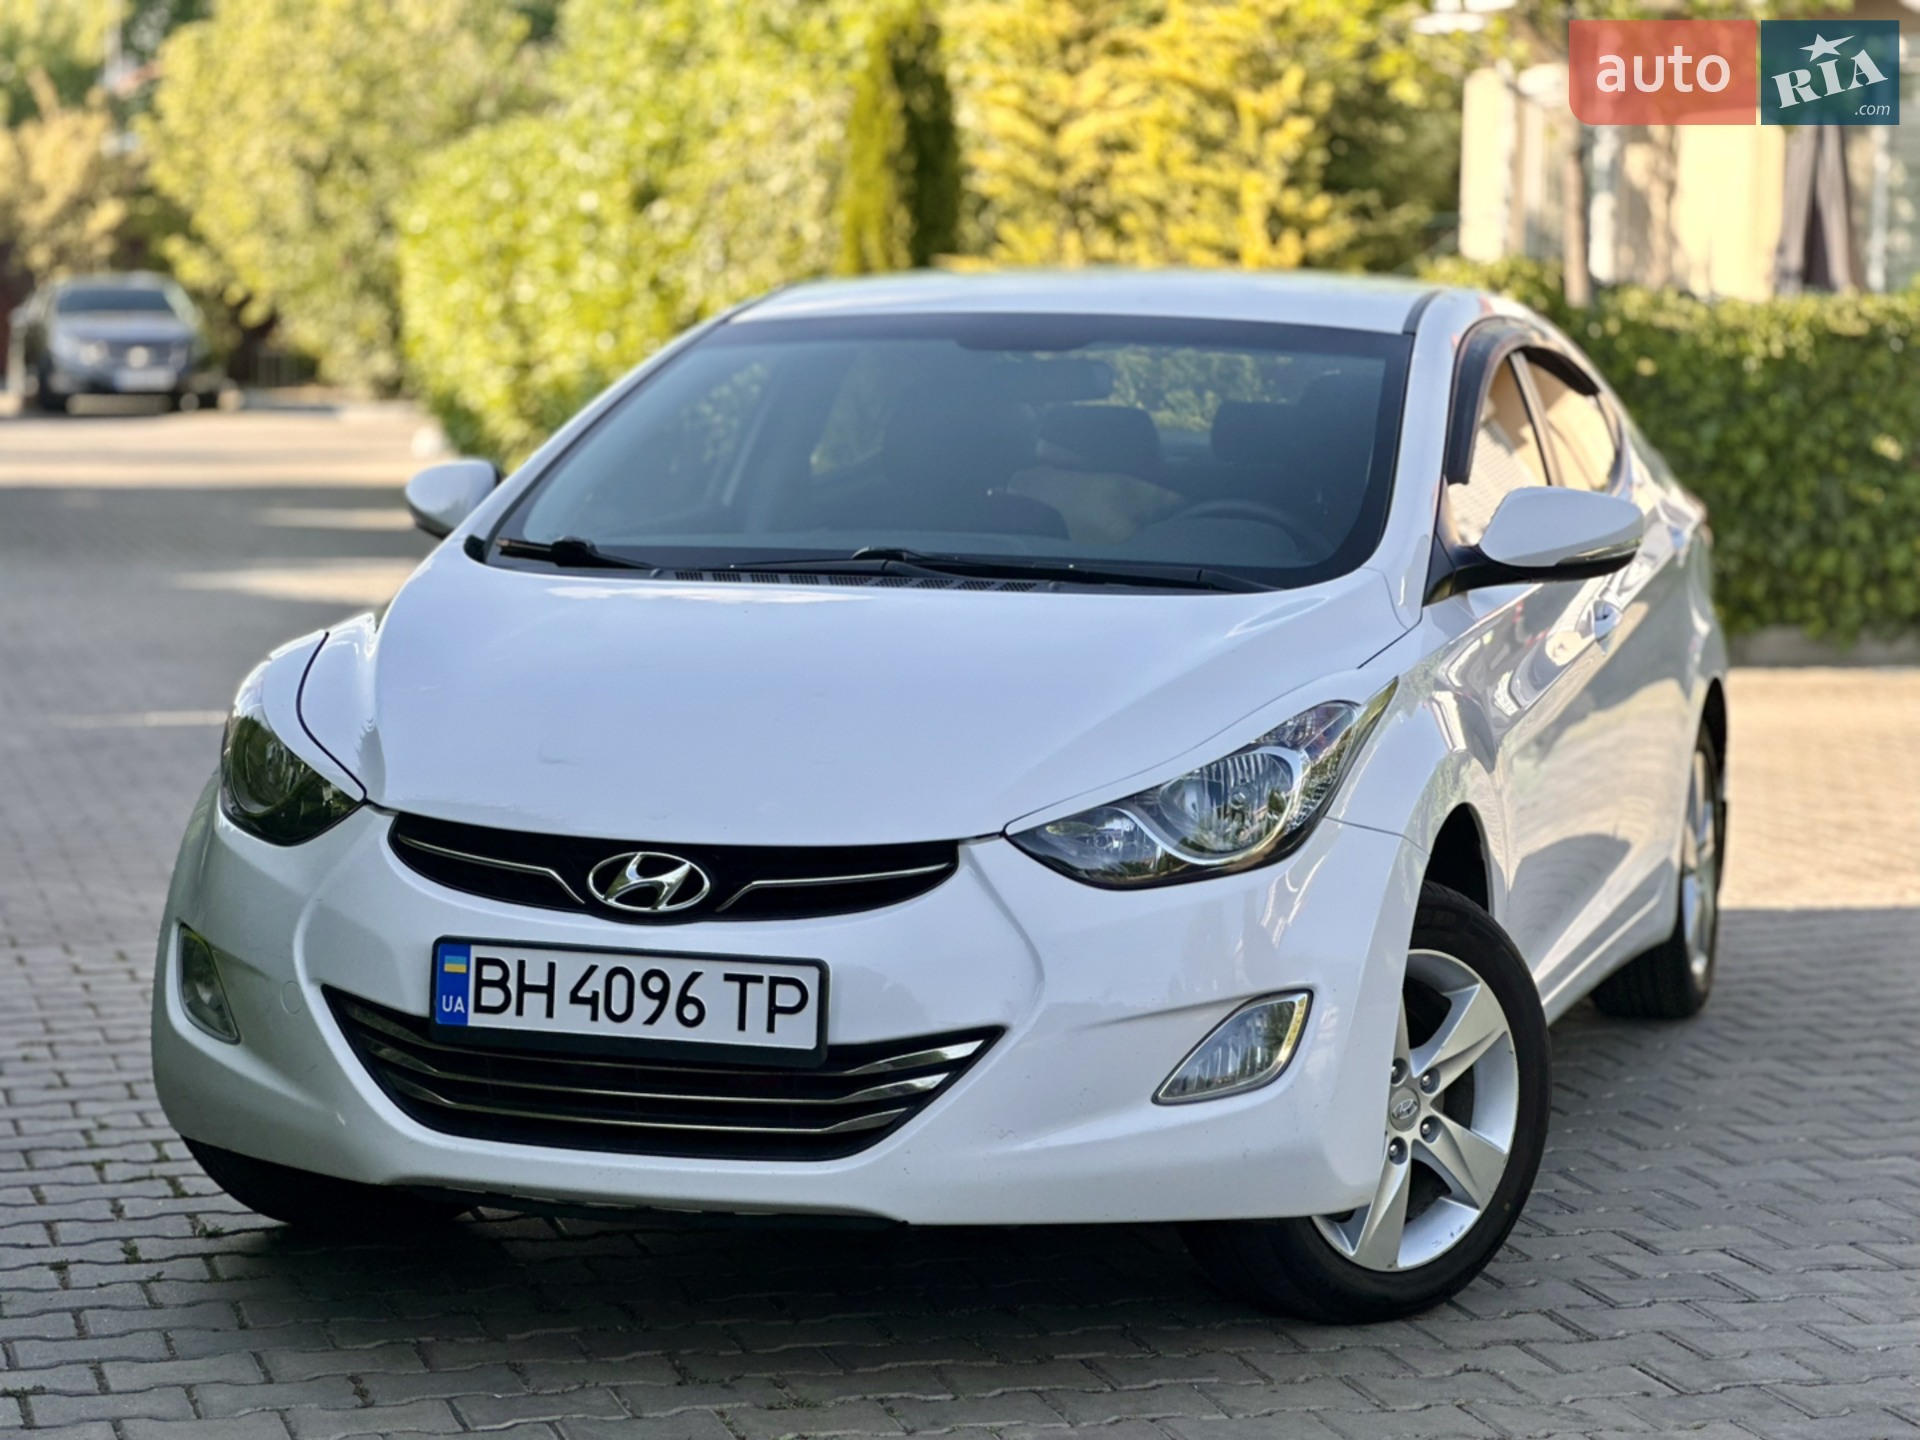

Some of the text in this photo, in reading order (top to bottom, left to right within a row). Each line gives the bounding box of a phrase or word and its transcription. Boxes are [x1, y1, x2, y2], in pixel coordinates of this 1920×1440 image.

[441, 994, 465, 1014] UA
[473, 956, 810, 1034] BH 4096 TP
